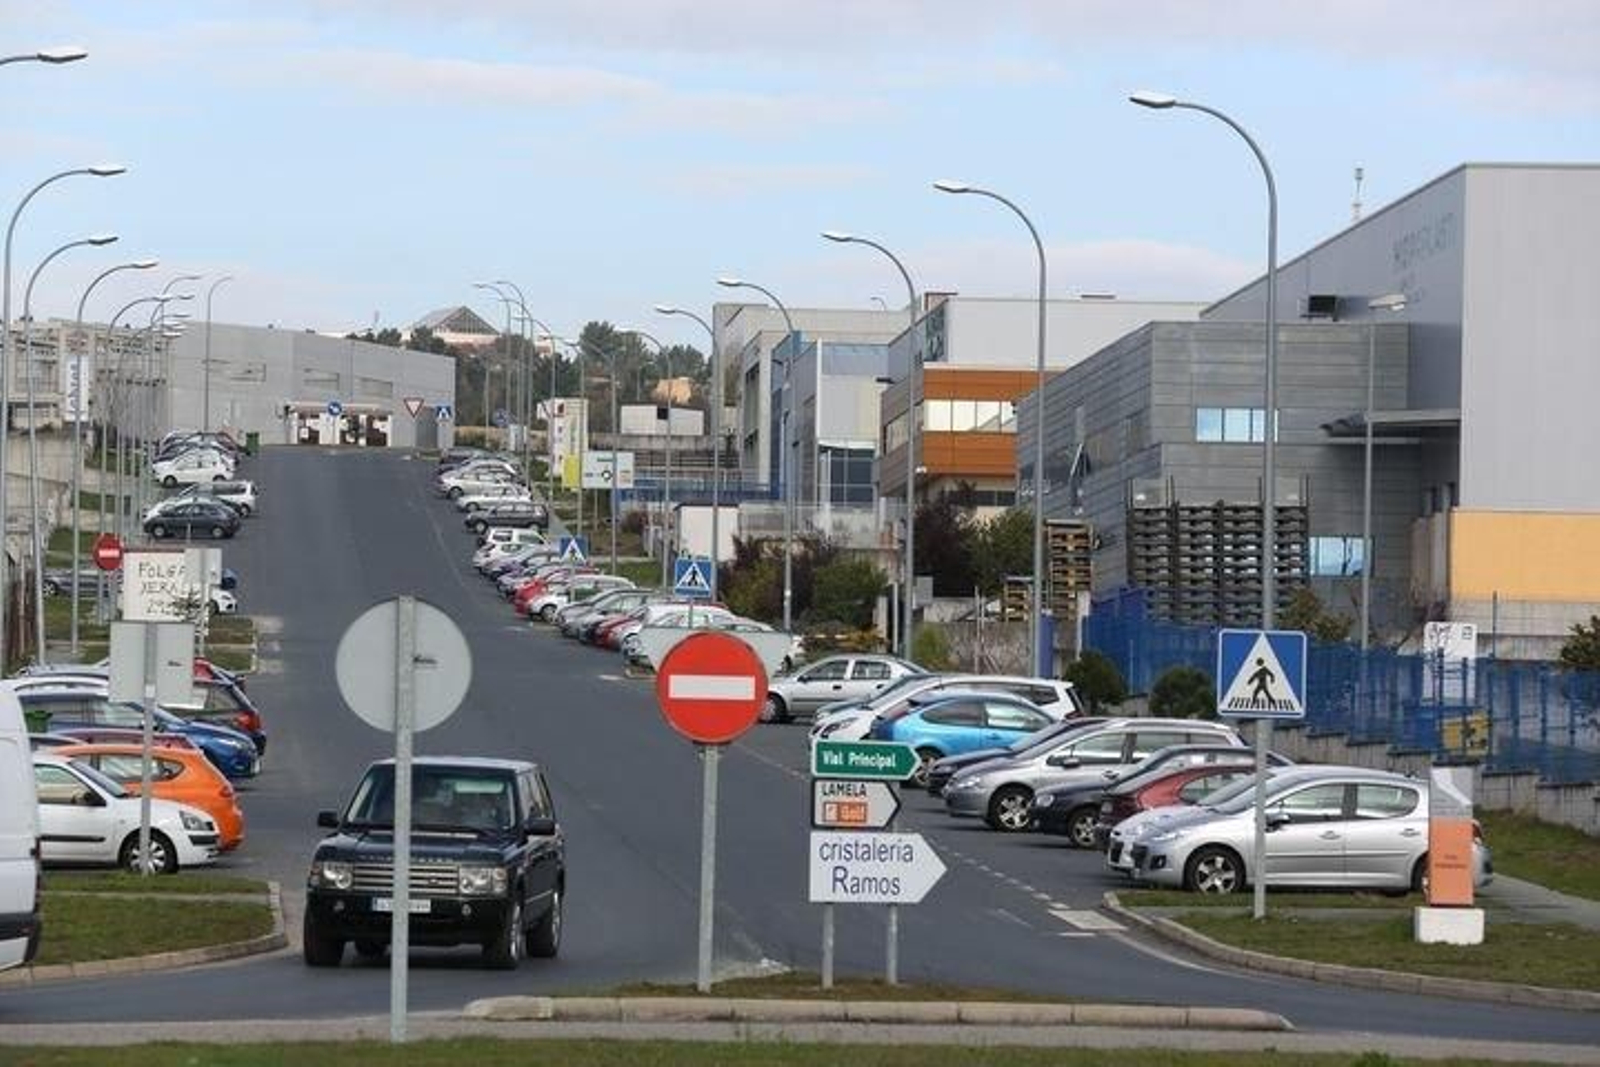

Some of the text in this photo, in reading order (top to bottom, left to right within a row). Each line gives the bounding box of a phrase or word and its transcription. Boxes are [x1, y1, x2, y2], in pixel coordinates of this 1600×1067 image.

[823, 751, 896, 771] Vial Principal
[822, 783, 867, 797] LAMELA
[832, 866, 901, 895] Ramos
